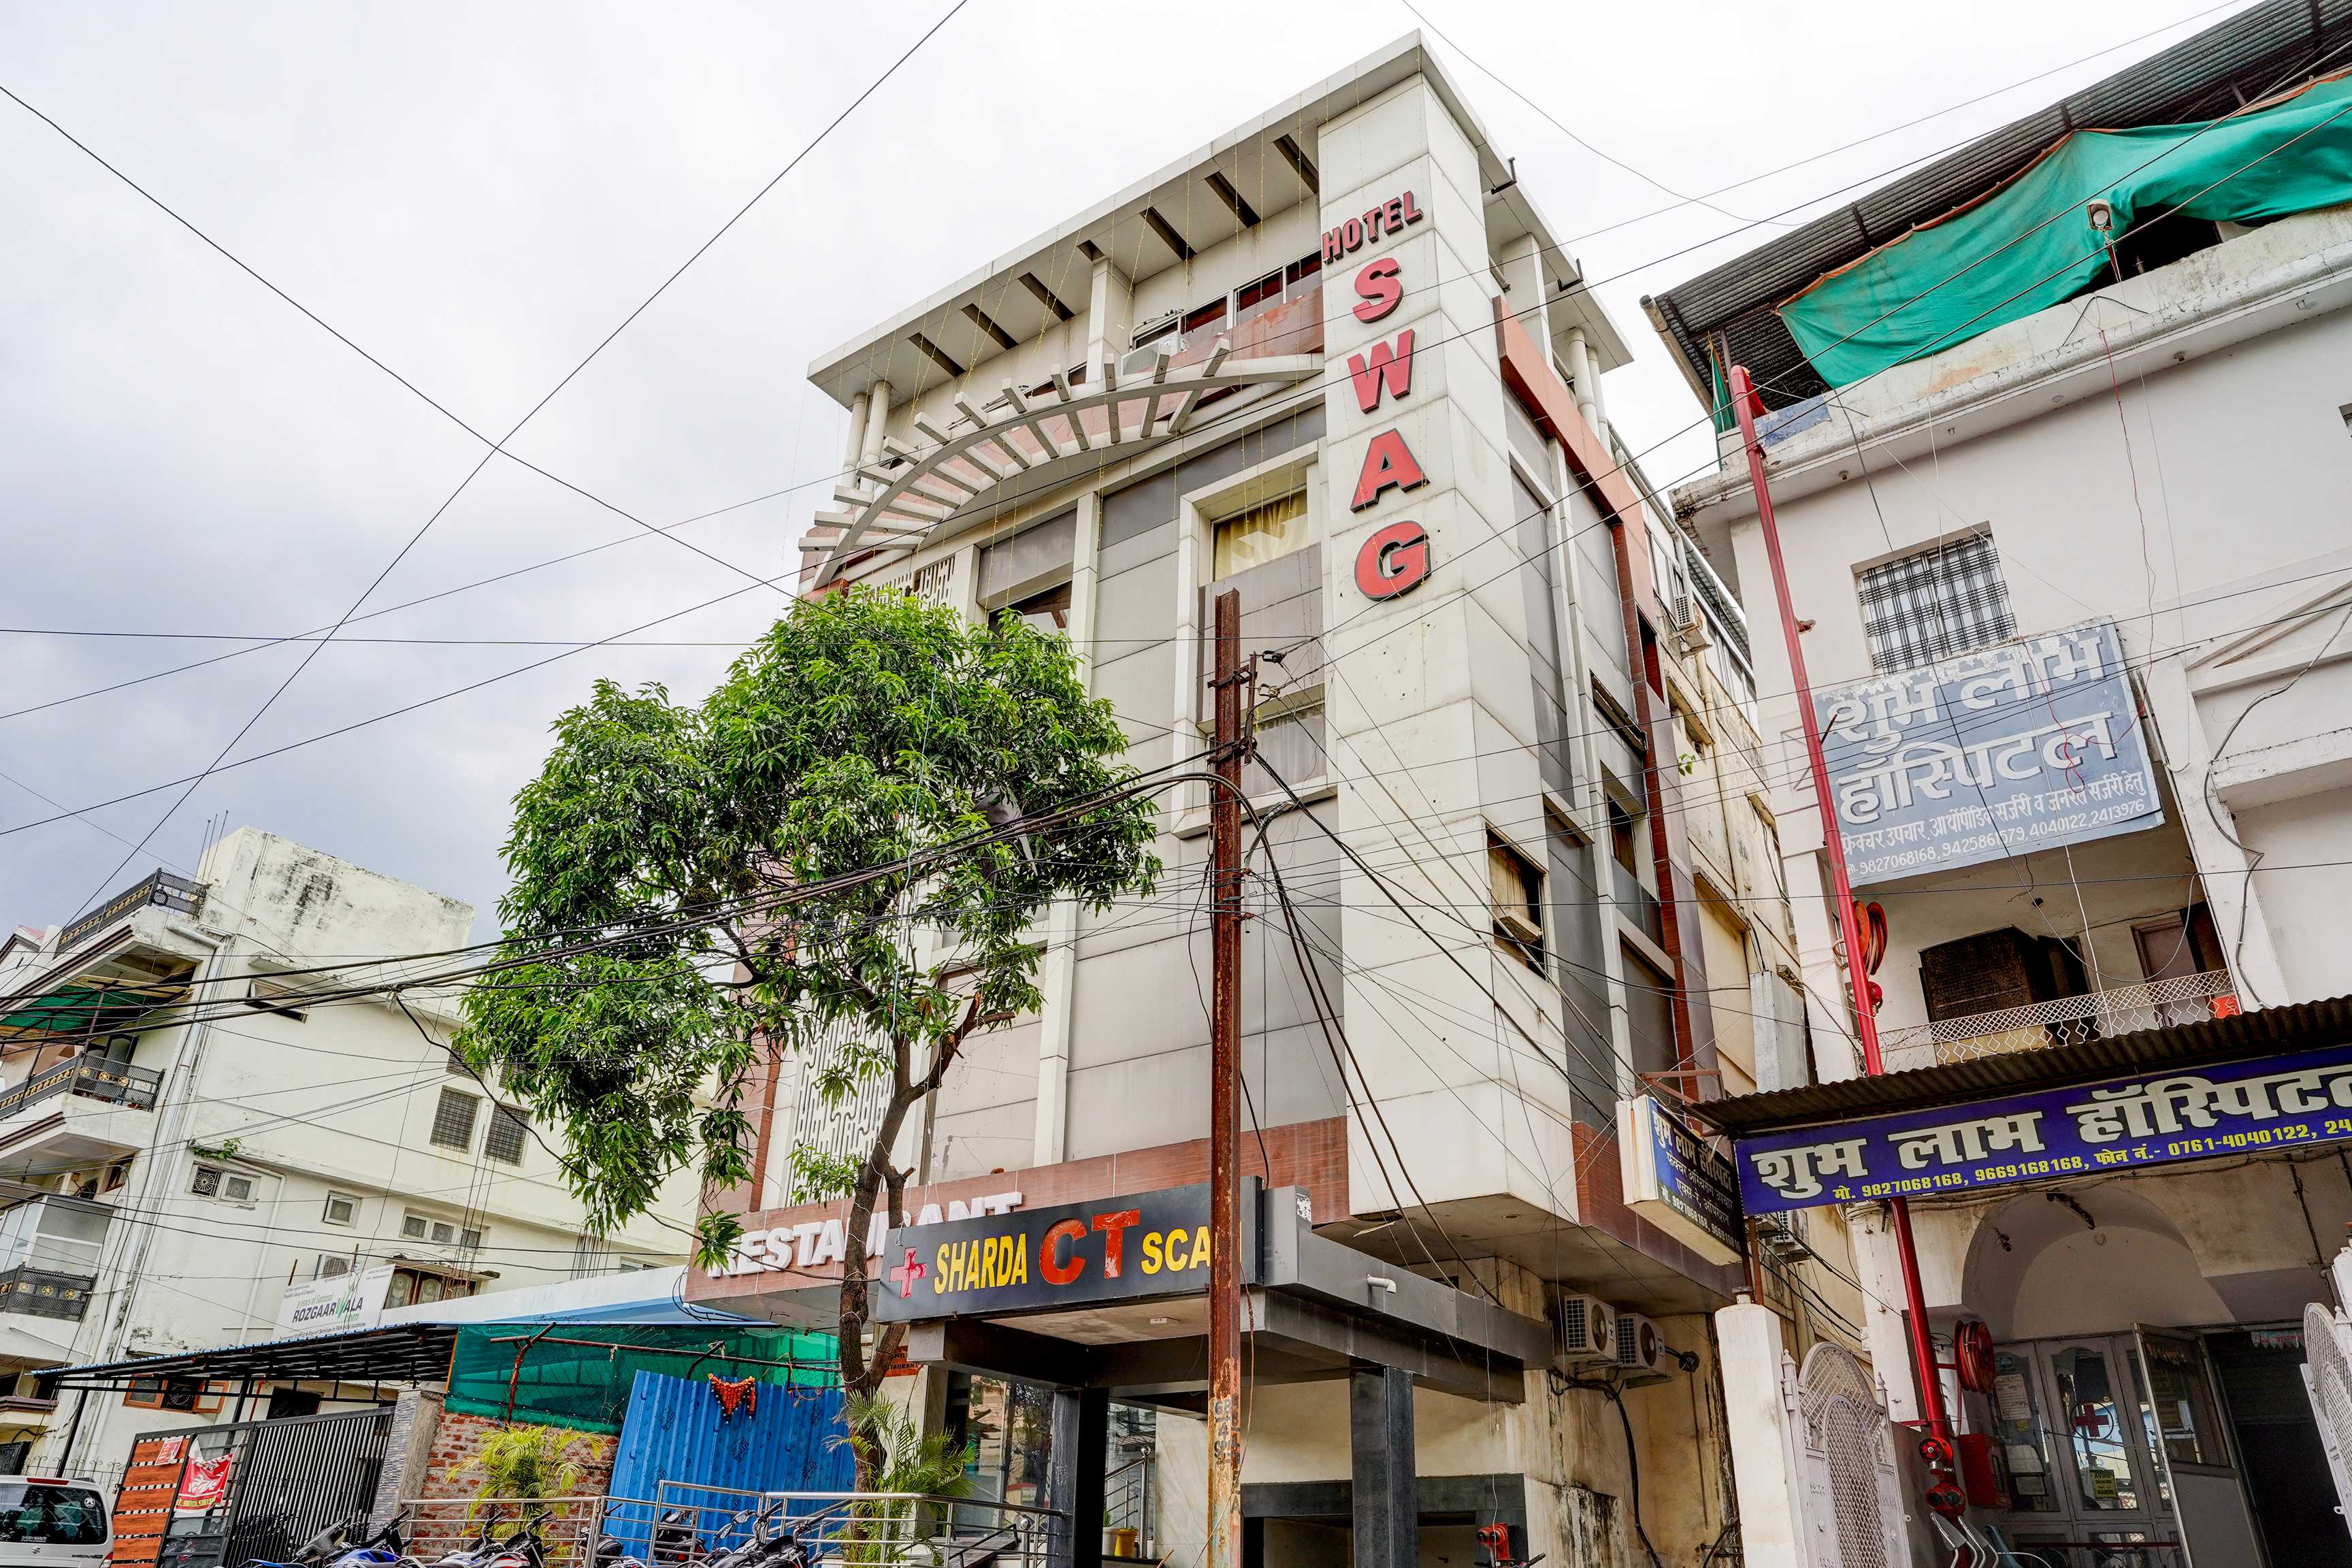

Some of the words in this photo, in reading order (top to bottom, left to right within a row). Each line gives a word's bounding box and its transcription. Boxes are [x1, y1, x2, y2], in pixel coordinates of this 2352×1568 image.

[1322, 191, 1424, 264] HOTEL
[1347, 257, 1431, 602] SWAG
[1827, 675, 1941, 753] शुभ
[1953, 634, 2104, 710] लाभ
[1837, 711, 2117, 825] हॉस्पिटल
[1652, 1110, 1672, 1148] शुभ
[1673, 1128, 1697, 1166] लाभ
[1750, 1138, 1868, 1198] शुभ
[1887, 1111, 2046, 1169] लाभ
[1833, 1185, 1857, 1200] मो.
[1862, 1173, 1968, 1198] 9827068168,
[1975, 1157, 2090, 1181] 9669168168,
[2094, 1148, 2128, 1165] फोन
[933, 1233, 1028, 1294] SHARDA
[1039, 1209, 1141, 1285] CT
[1141, 1222, 1242, 1275] SCA
[292, 1296, 363, 1323] ROZGAARWALA
